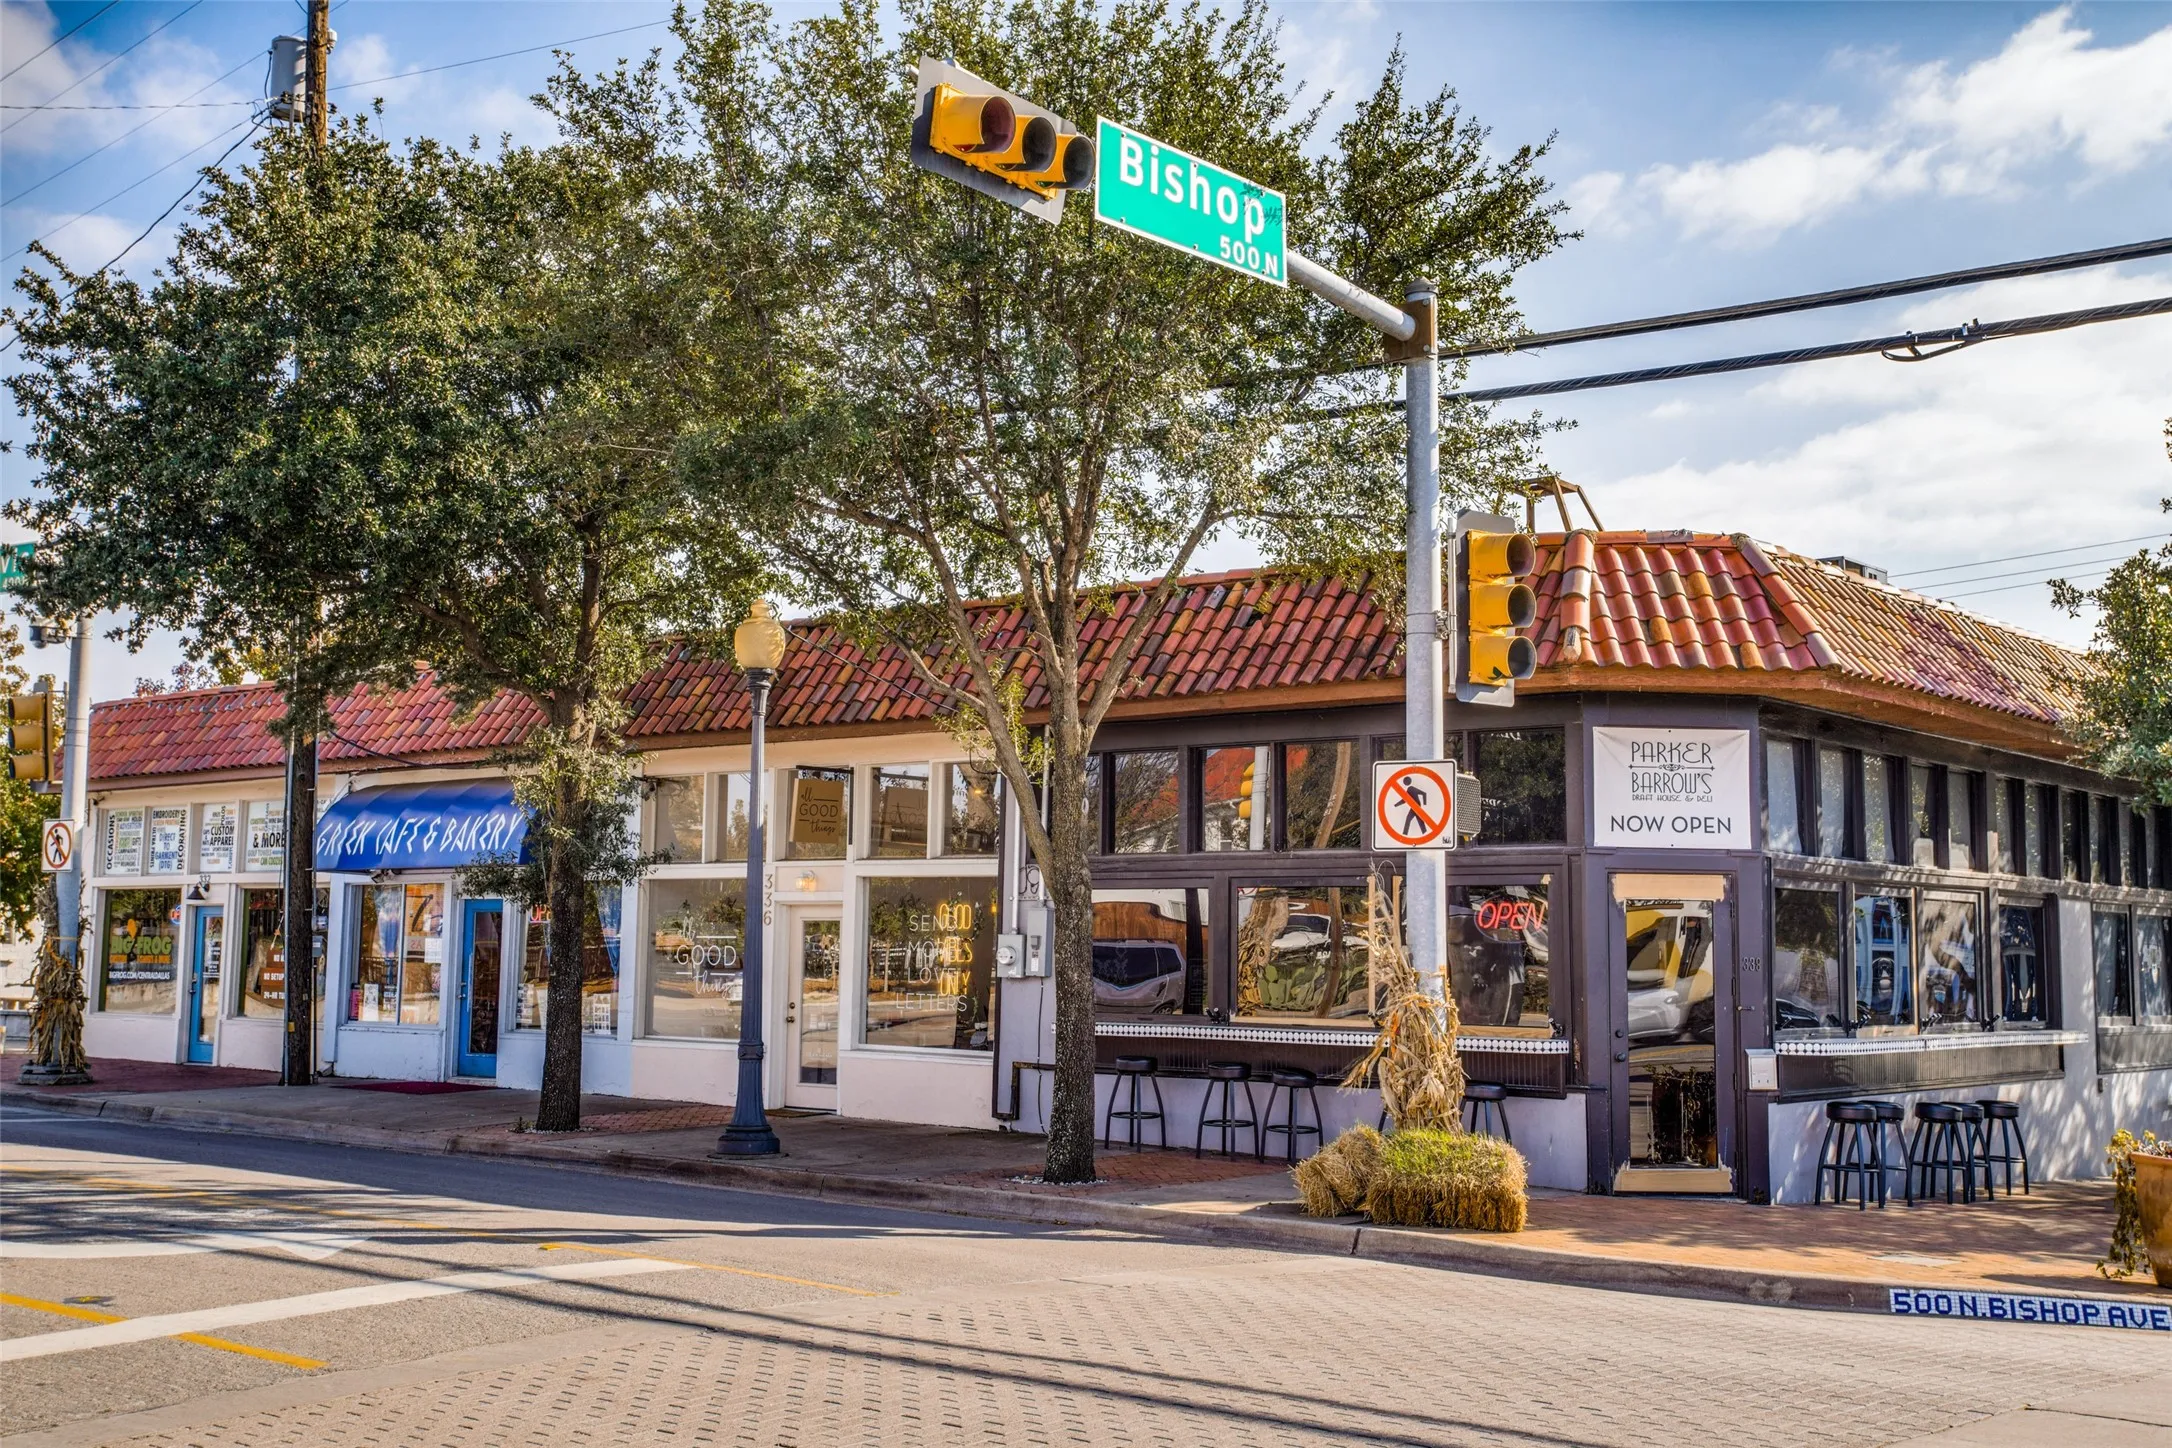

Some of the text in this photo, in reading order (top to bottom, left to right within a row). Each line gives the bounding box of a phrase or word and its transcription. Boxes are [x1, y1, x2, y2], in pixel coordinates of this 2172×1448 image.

[1119, 136, 1265, 244] Bishop
[1219, 235, 1279, 278] 500 N
[1630, 741, 1713, 764] PARKER
[1630, 771, 1713, 795] BARROW'S
[800, 786, 812, 803] all
[1656, 794, 1682, 802] HOUSE
[1684, 794, 1695, 802] &
[799, 803, 839, 818] GOOD
[210, 820, 235, 836] CUSTOM
[809, 820, 836, 836] things
[1610, 814, 1732, 834] NOW OPEN
[107, 814, 116, 870] OCCASIONS
[159, 832, 176, 842] DIRECT
[177, 809, 187, 870] DECORATING
[209, 835, 234, 847] APPAREL
[252, 832, 286, 849] & MORE
[316, 812, 526, 857] GREEK CAFE & BAKERY
[155, 850, 178, 860] GARMENT
[763, 873, 773, 926] 336
[909, 914, 958, 932] SEND
[1478, 901, 1546, 930] OPEN
[110, 935, 172, 955] BIG FROG
[676, 944, 737, 966] GOOD
[1741, 956, 1761, 972] 338
[907, 966, 958, 984] LOVE
[895, 992, 968, 1012] LETTERS
[1893, 1291, 1954, 1315] 500
[1987, 1296, 2100, 1327] BISHOP
[2107, 1305, 2172, 1332] AVE
